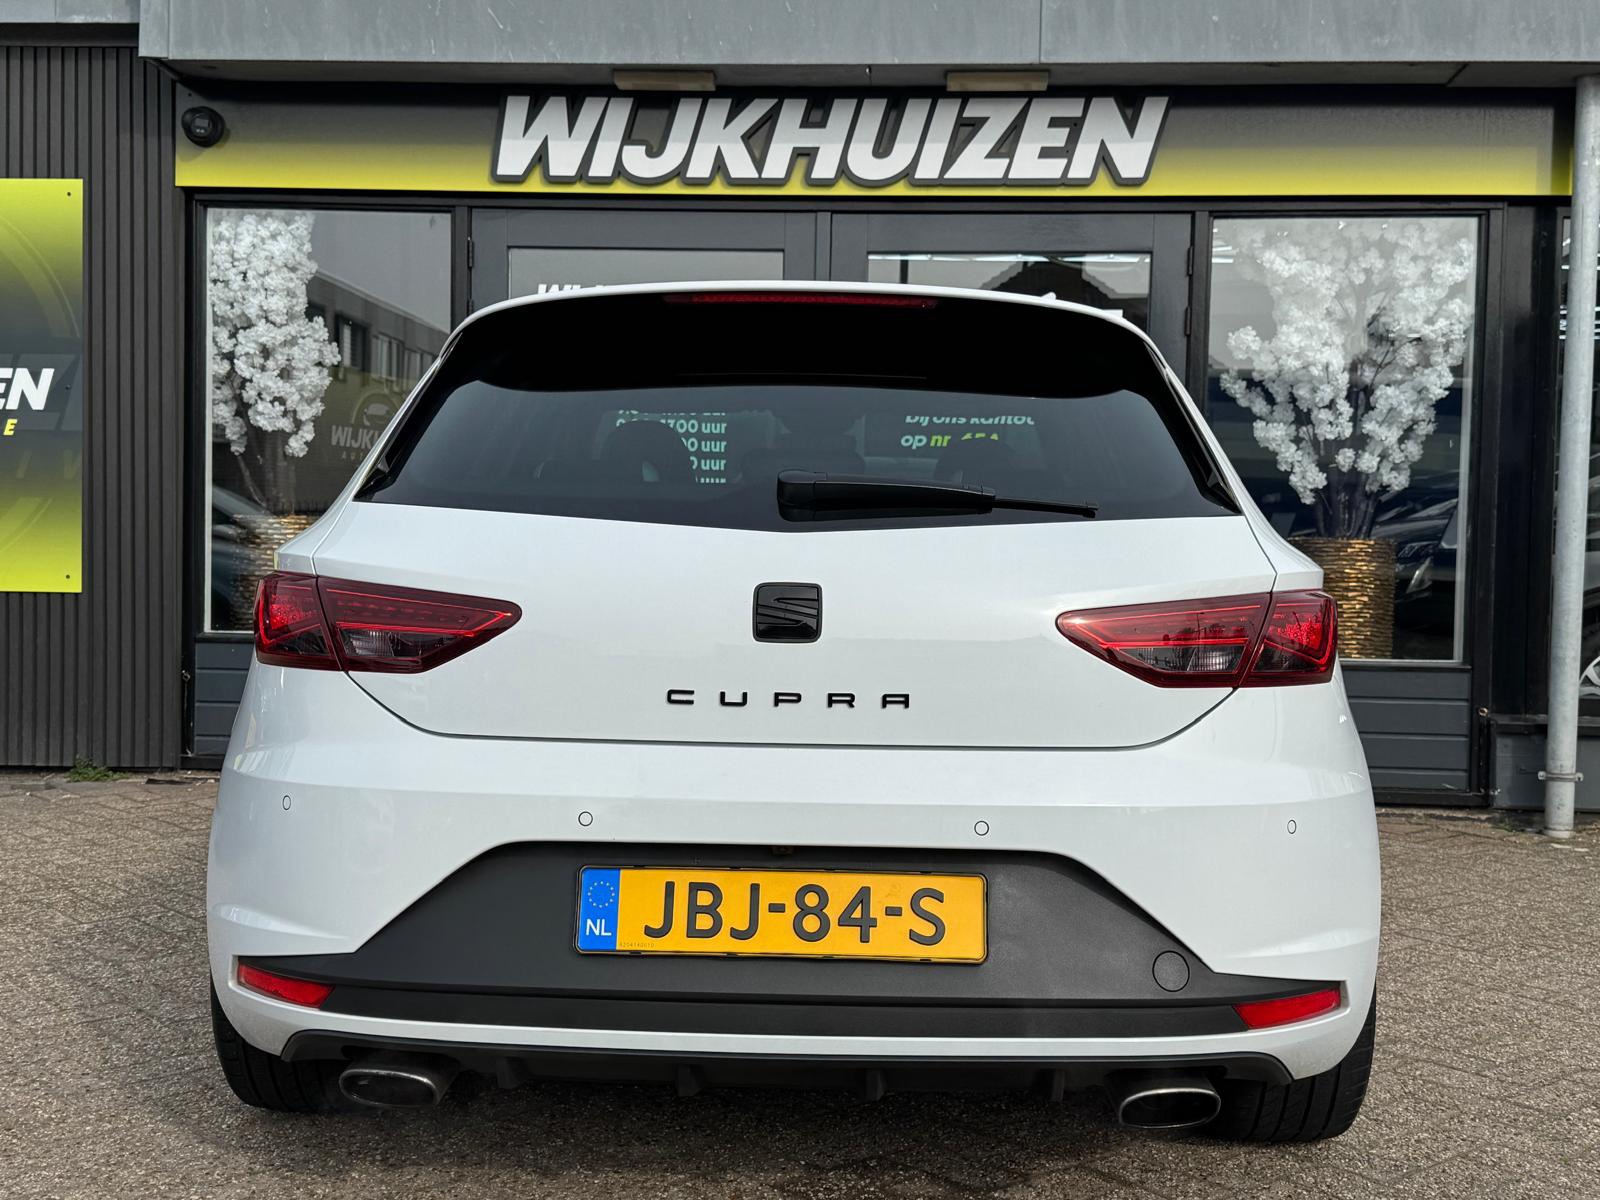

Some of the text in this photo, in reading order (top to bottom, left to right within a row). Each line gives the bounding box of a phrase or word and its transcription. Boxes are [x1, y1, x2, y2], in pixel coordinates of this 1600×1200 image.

[494, 95, 1169, 184] WIJKHUIZEN
[701, 421, 727, 434] uur
[701, 440, 727, 453] uur
[900, 434, 927, 450] op
[930, 434, 951, 447] nr
[701, 458, 727, 471] uur
[666, 689, 910, 709] CUPRA
[643, 880, 947, 946] JBJ-84-S
[585, 918, 612, 937] NL
